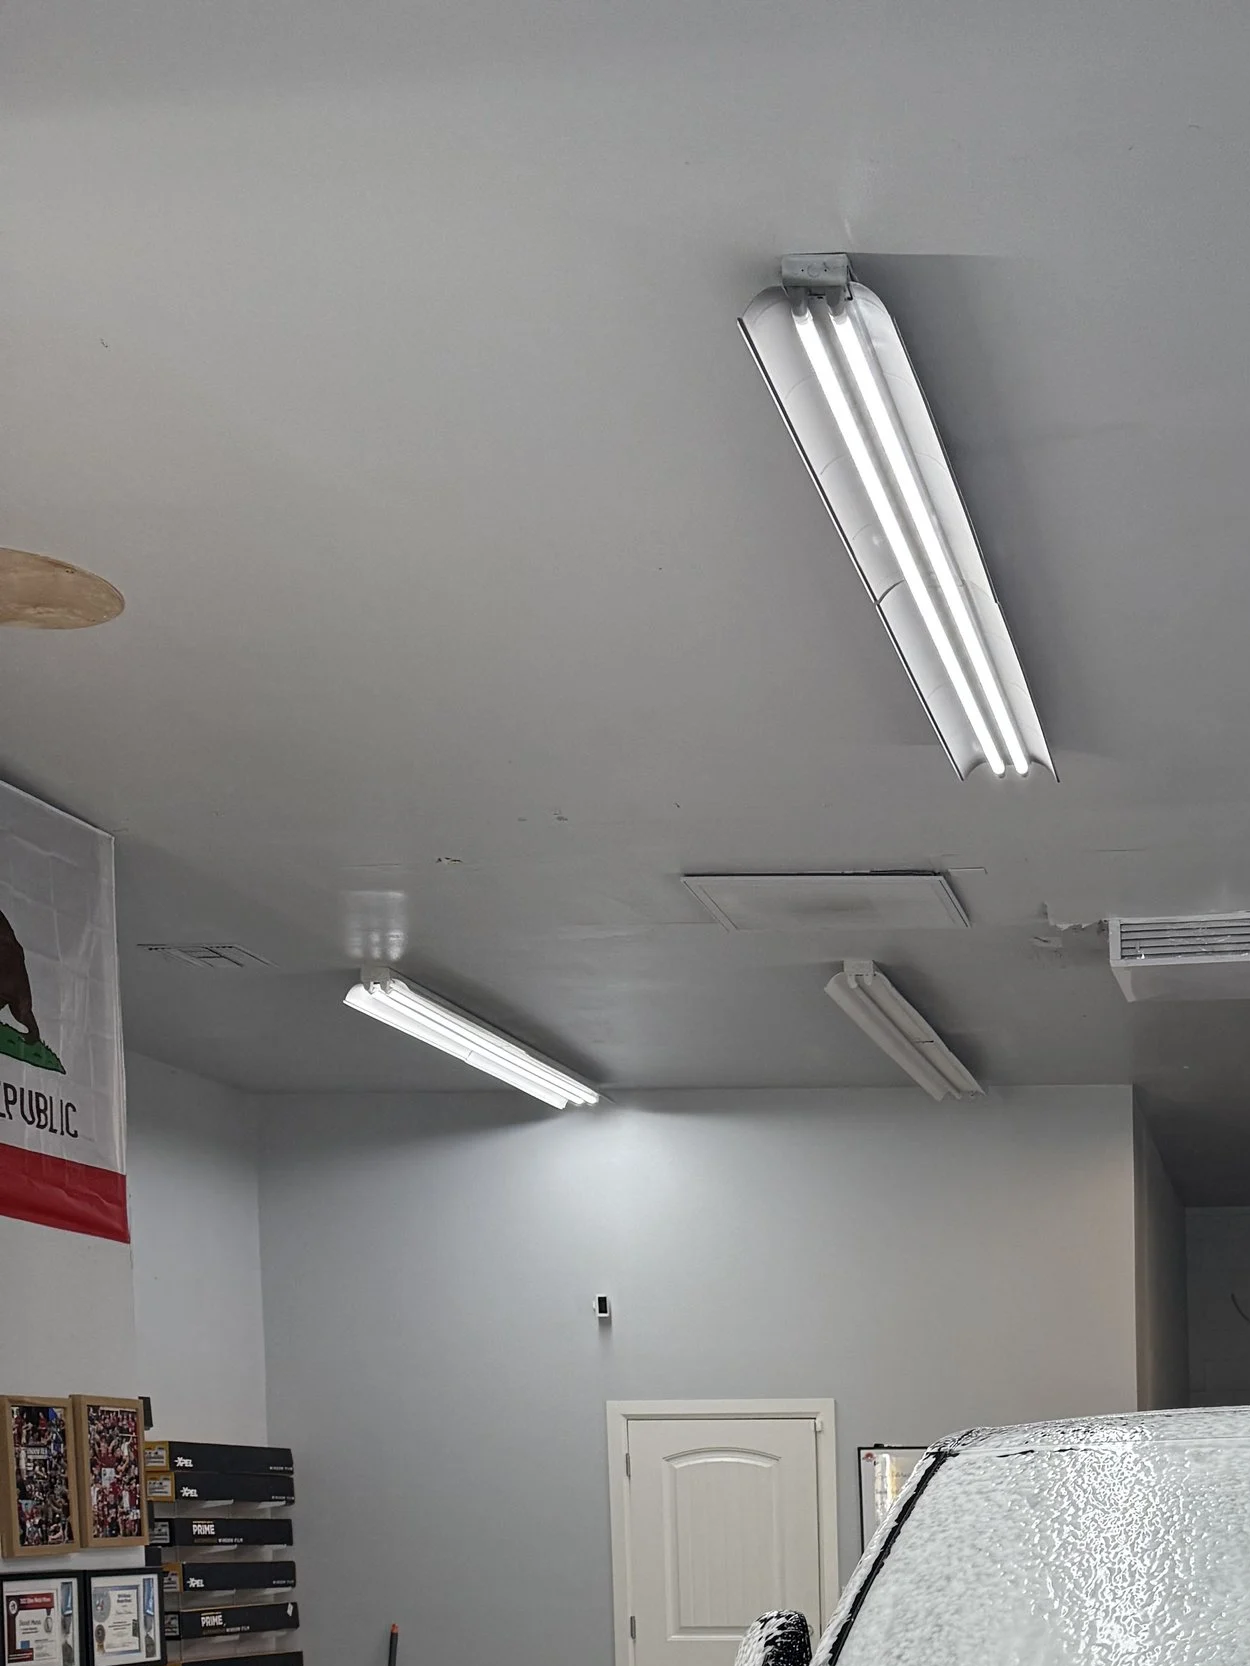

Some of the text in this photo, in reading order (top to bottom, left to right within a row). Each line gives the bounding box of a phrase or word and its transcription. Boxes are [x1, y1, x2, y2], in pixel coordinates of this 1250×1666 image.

[175, 1456, 194, 1468] XPEL
[181, 1486, 199, 1498] XPEL
[192, 1524, 216, 1535] PRIME
[187, 1577, 205, 1588] XPEL
[201, 1614, 223, 1627] PRIME
